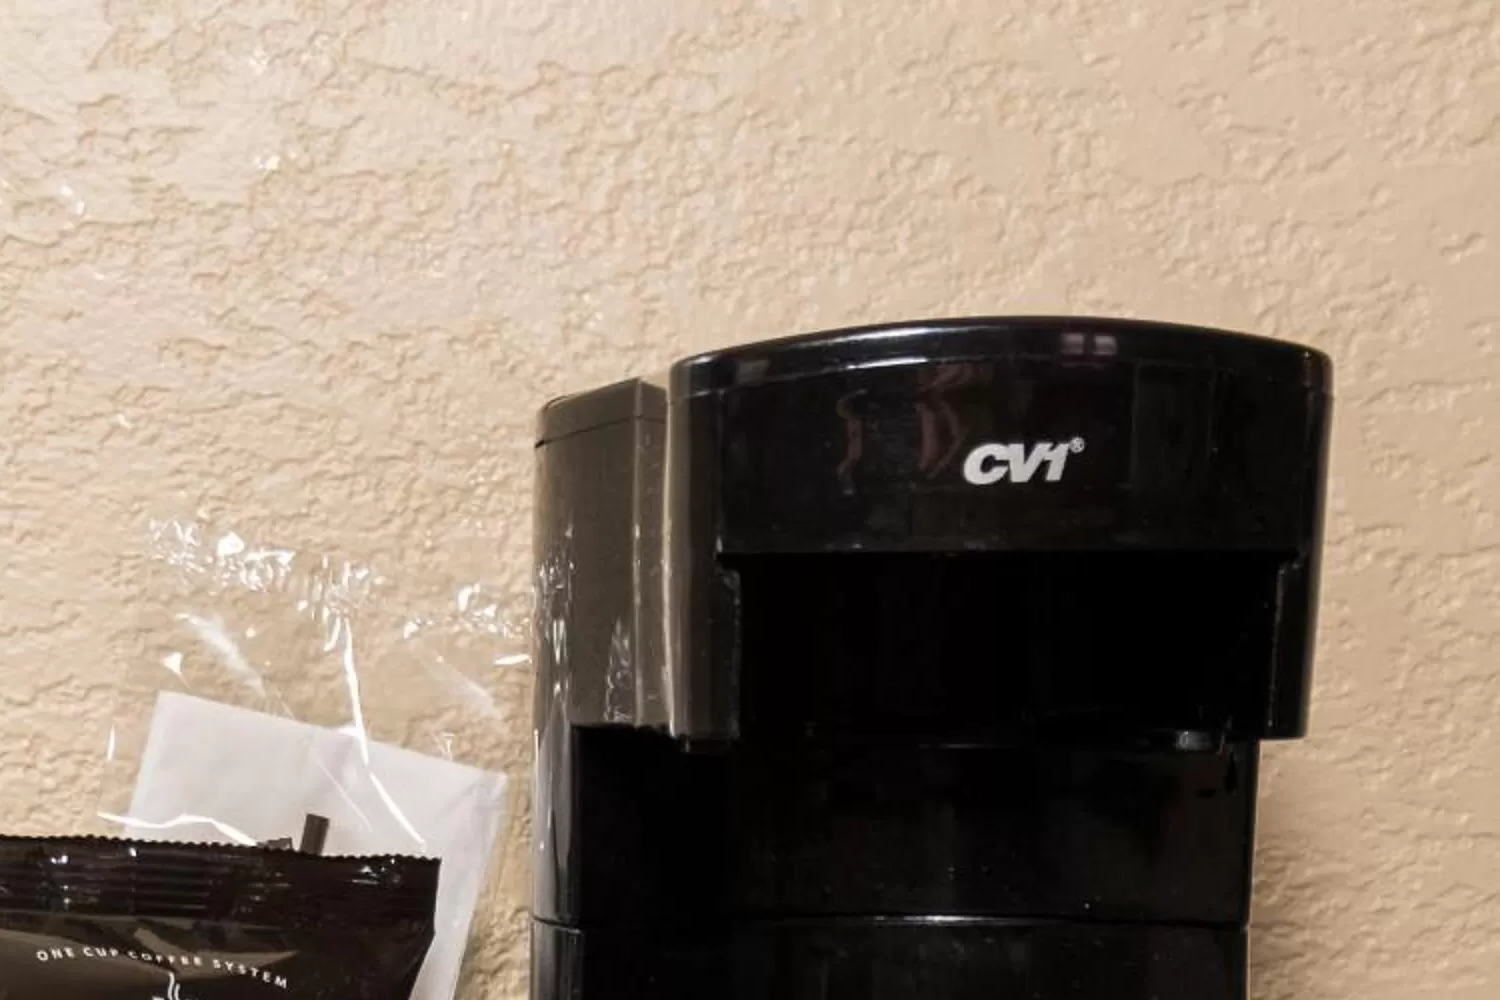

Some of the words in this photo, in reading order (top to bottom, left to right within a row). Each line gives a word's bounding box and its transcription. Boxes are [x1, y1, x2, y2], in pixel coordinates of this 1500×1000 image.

[36, 948, 75, 962] ONE
[83, 947, 118, 958] CUP
[128, 951, 202, 966] COFFEE
[212, 958, 288, 989] SYSTEM
